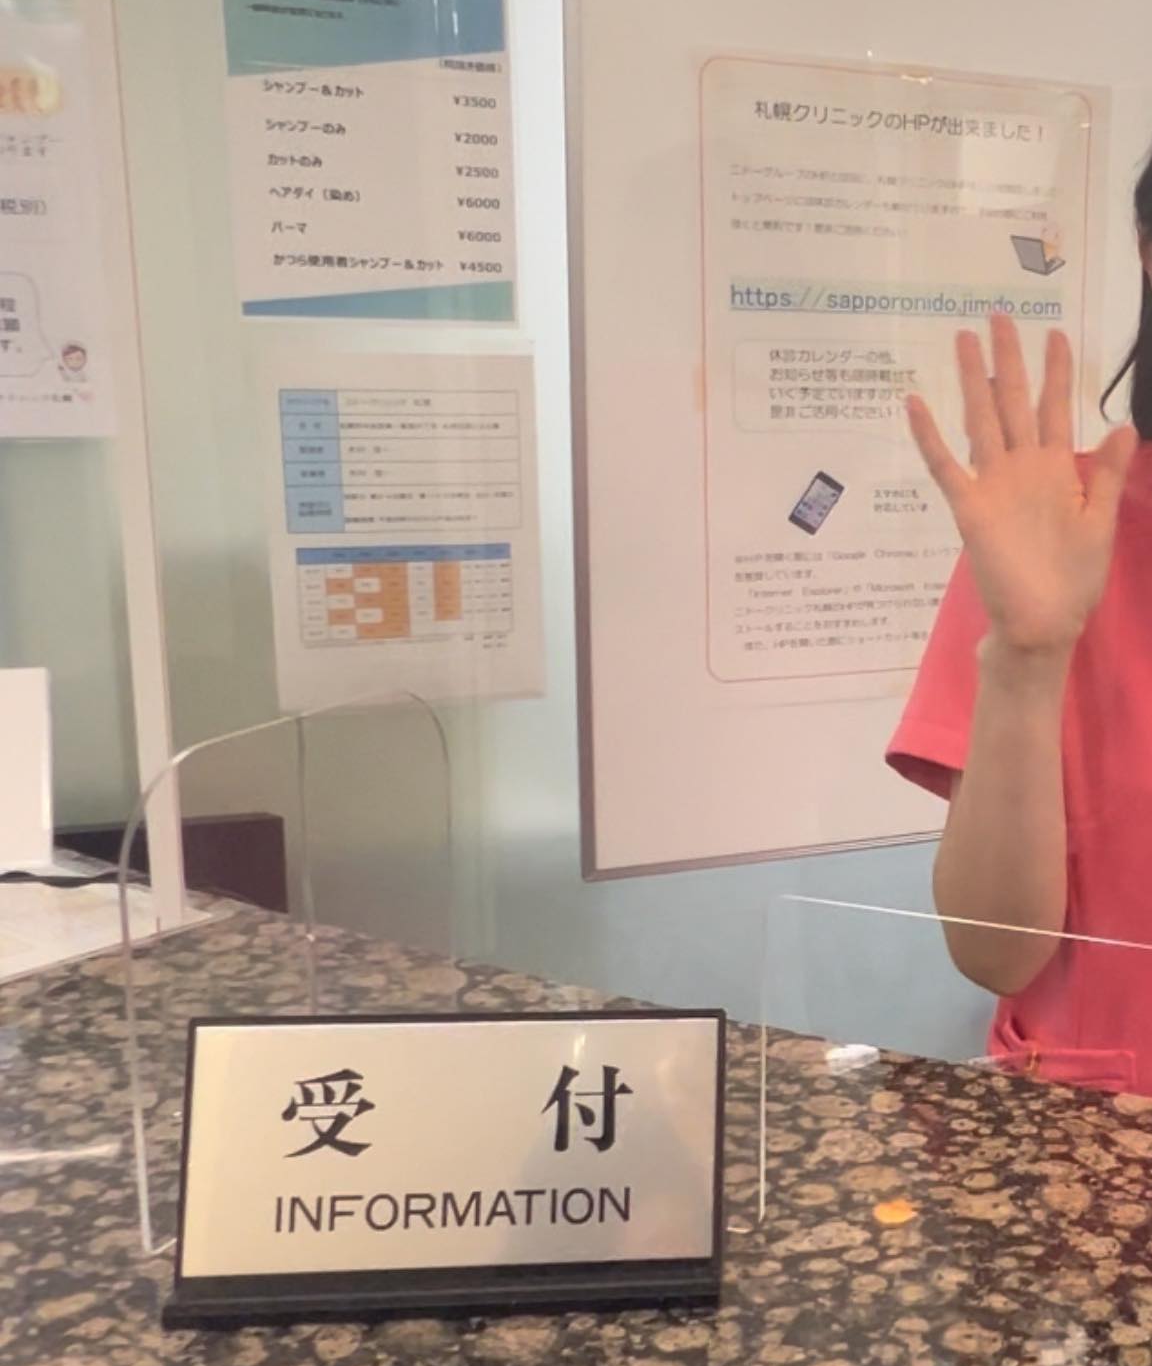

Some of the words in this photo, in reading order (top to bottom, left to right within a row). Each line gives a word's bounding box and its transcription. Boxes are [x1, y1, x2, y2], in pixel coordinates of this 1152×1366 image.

[453, 95, 497, 109] ¥3500
[265, 118, 347, 135] シャンプーのみ
[454, 132, 498, 146] ¥2000
[267, 153, 323, 169] カットのみ
[456, 166, 500, 179] ¥2500
[457, 197, 501, 210] ¥6000
[457, 230, 502, 243] ¥6000
[459, 261, 503, 274] ¥4500
[274, 1186, 631, 1234] INFORMATION
